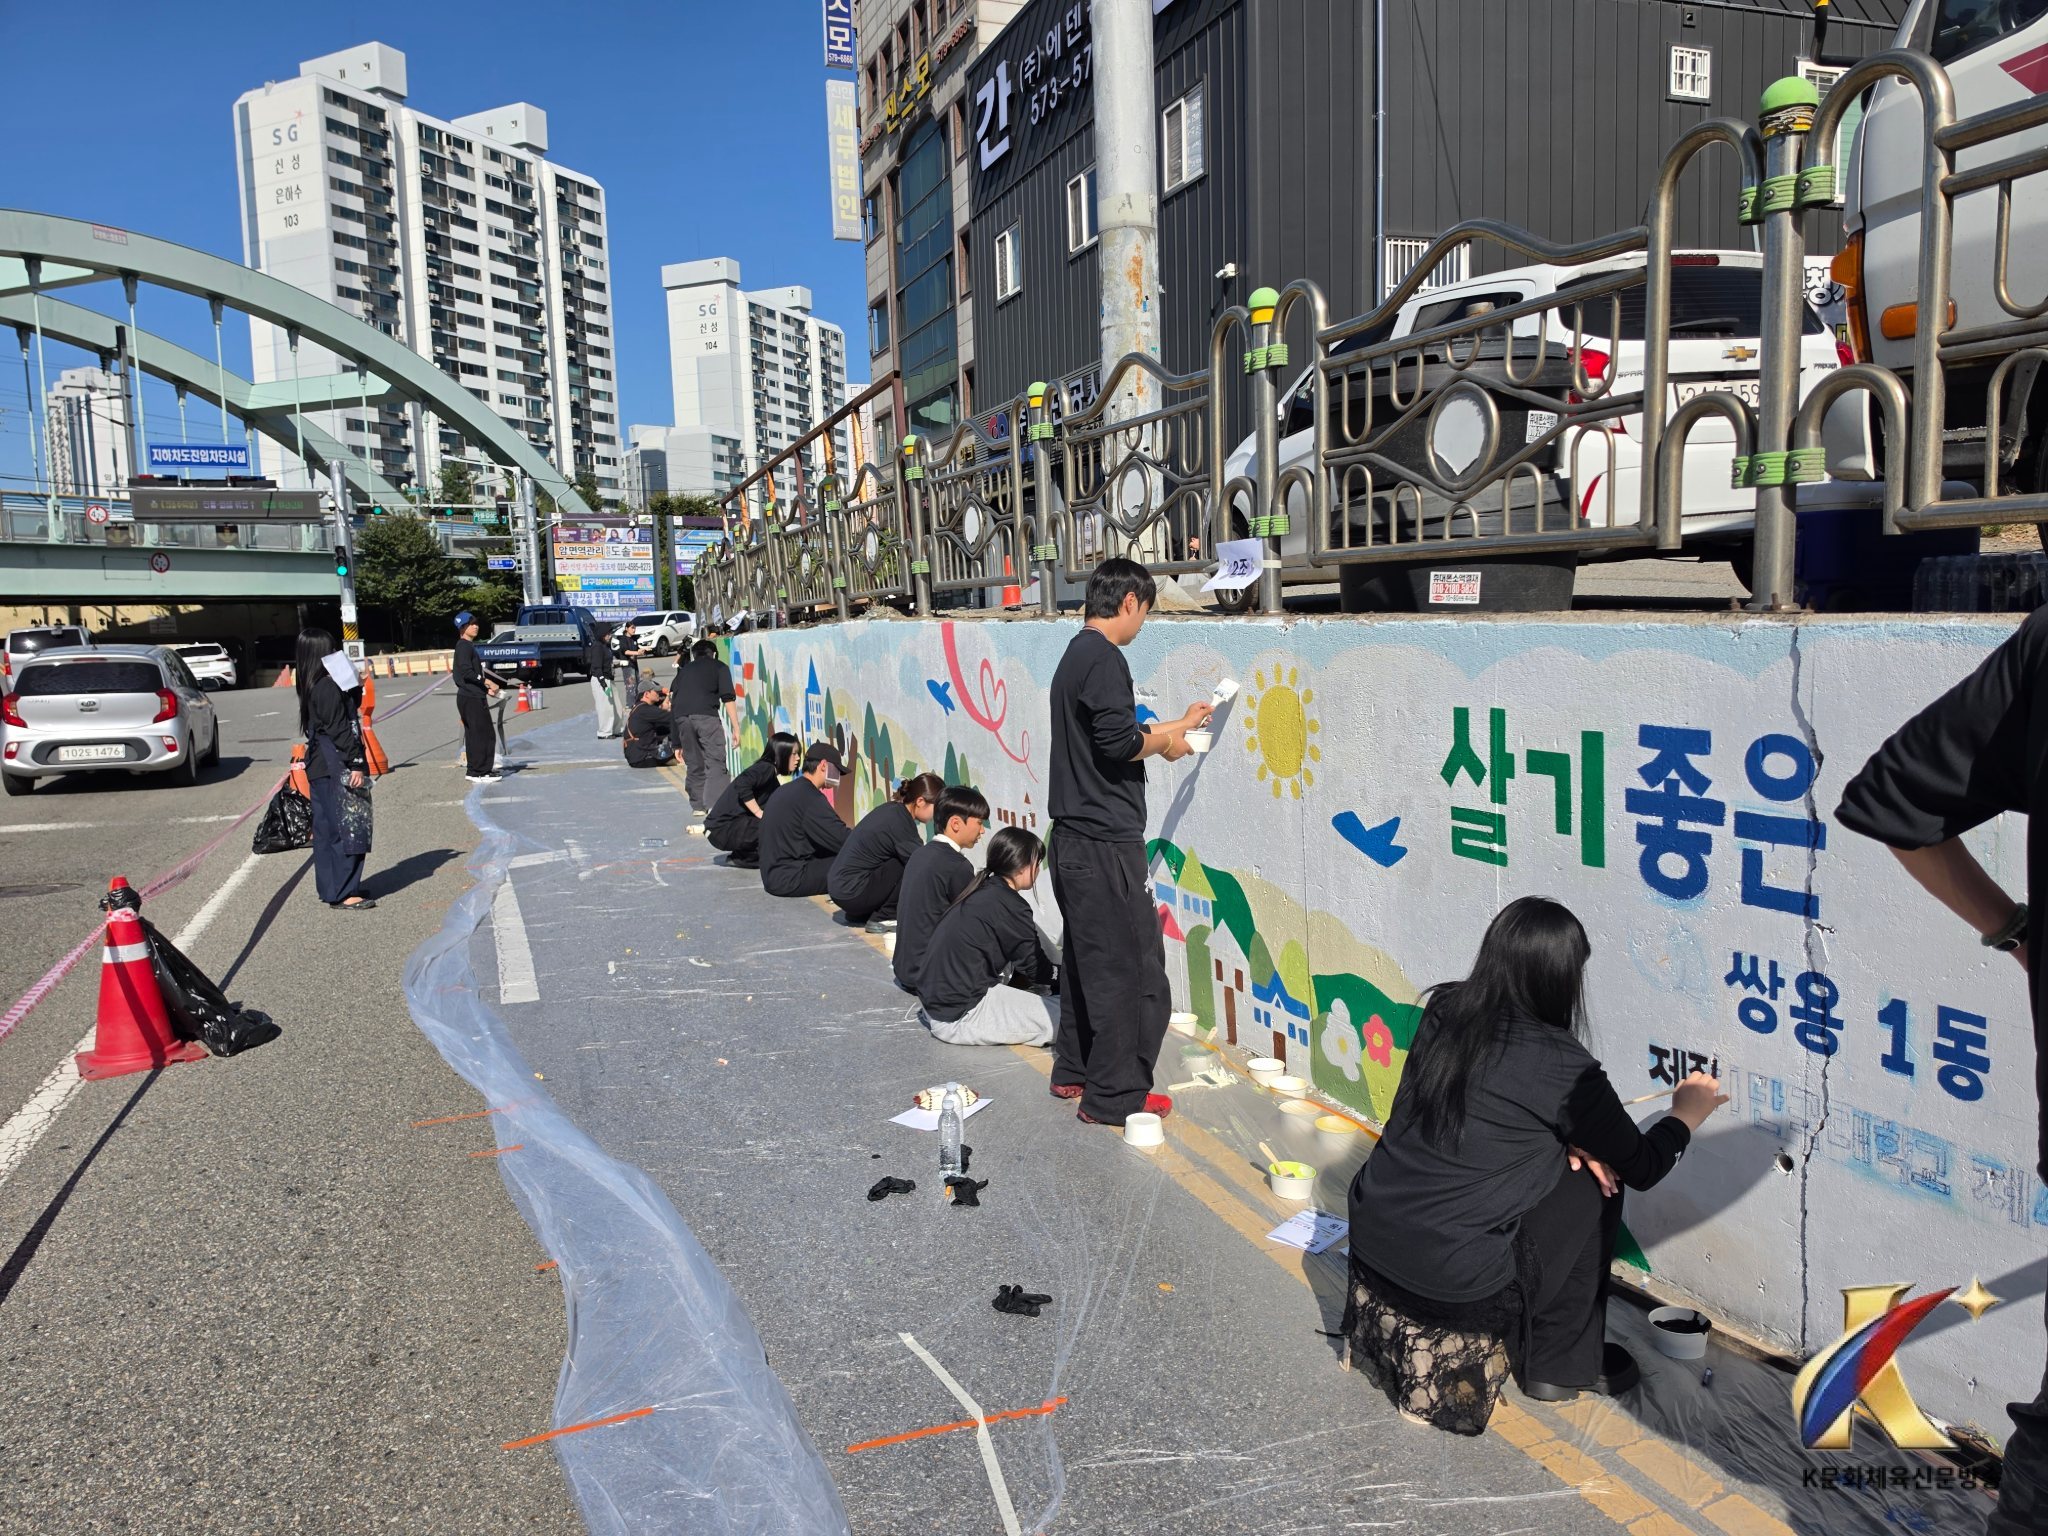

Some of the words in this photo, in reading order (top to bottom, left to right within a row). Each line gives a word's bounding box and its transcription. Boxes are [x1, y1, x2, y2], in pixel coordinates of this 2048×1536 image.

[976, 59, 1011, 171] 간
[272, 123, 299, 146] SG
[275, 153, 301, 175] 신성
[833, 104, 858, 221] 세무법인
[275, 184, 302, 205] 은하수
[283, 213, 299, 228] 103
[698, 303, 717, 317] SG
[700, 321, 718, 334] 신성
[705, 341, 718, 350] 104
[1617, 370, 1645, 379] SPAR
[151, 447, 247, 465] 지하차도진입차단시설
[1440, 706, 1606, 869] 살기
[1625, 723, 1827, 921] 좋은
[1724, 951, 1844, 1058] 쌍용
[1877, 998, 1991, 1103] 1동
